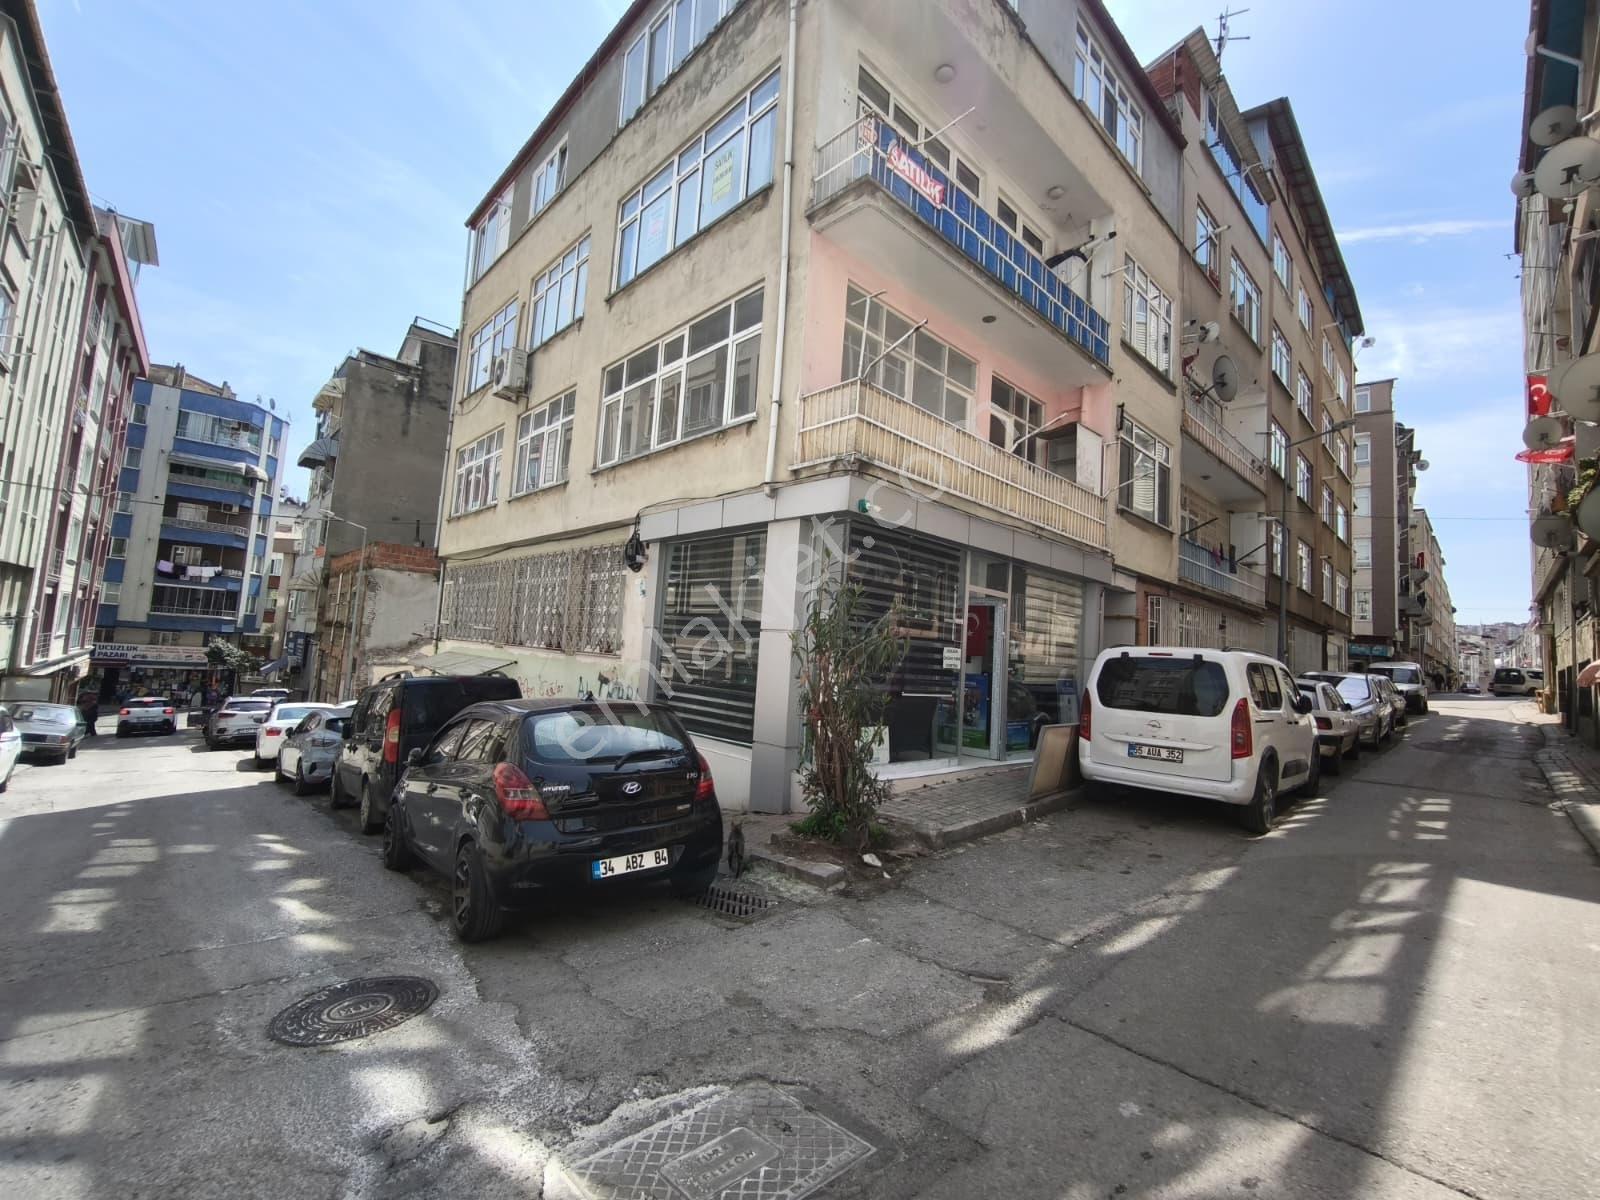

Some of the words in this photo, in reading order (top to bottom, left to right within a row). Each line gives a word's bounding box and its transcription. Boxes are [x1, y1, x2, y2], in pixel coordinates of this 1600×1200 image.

[98, 643, 139, 652] UCUZLUK
[97, 651, 128, 659] PAZARI
[1146, 747, 1162, 758] AUA
[1165, 749, 1182, 760] 352
[600, 861, 615, 876] 34
[625, 855, 645, 872] ABZ
[654, 850, 668, 865] 84
